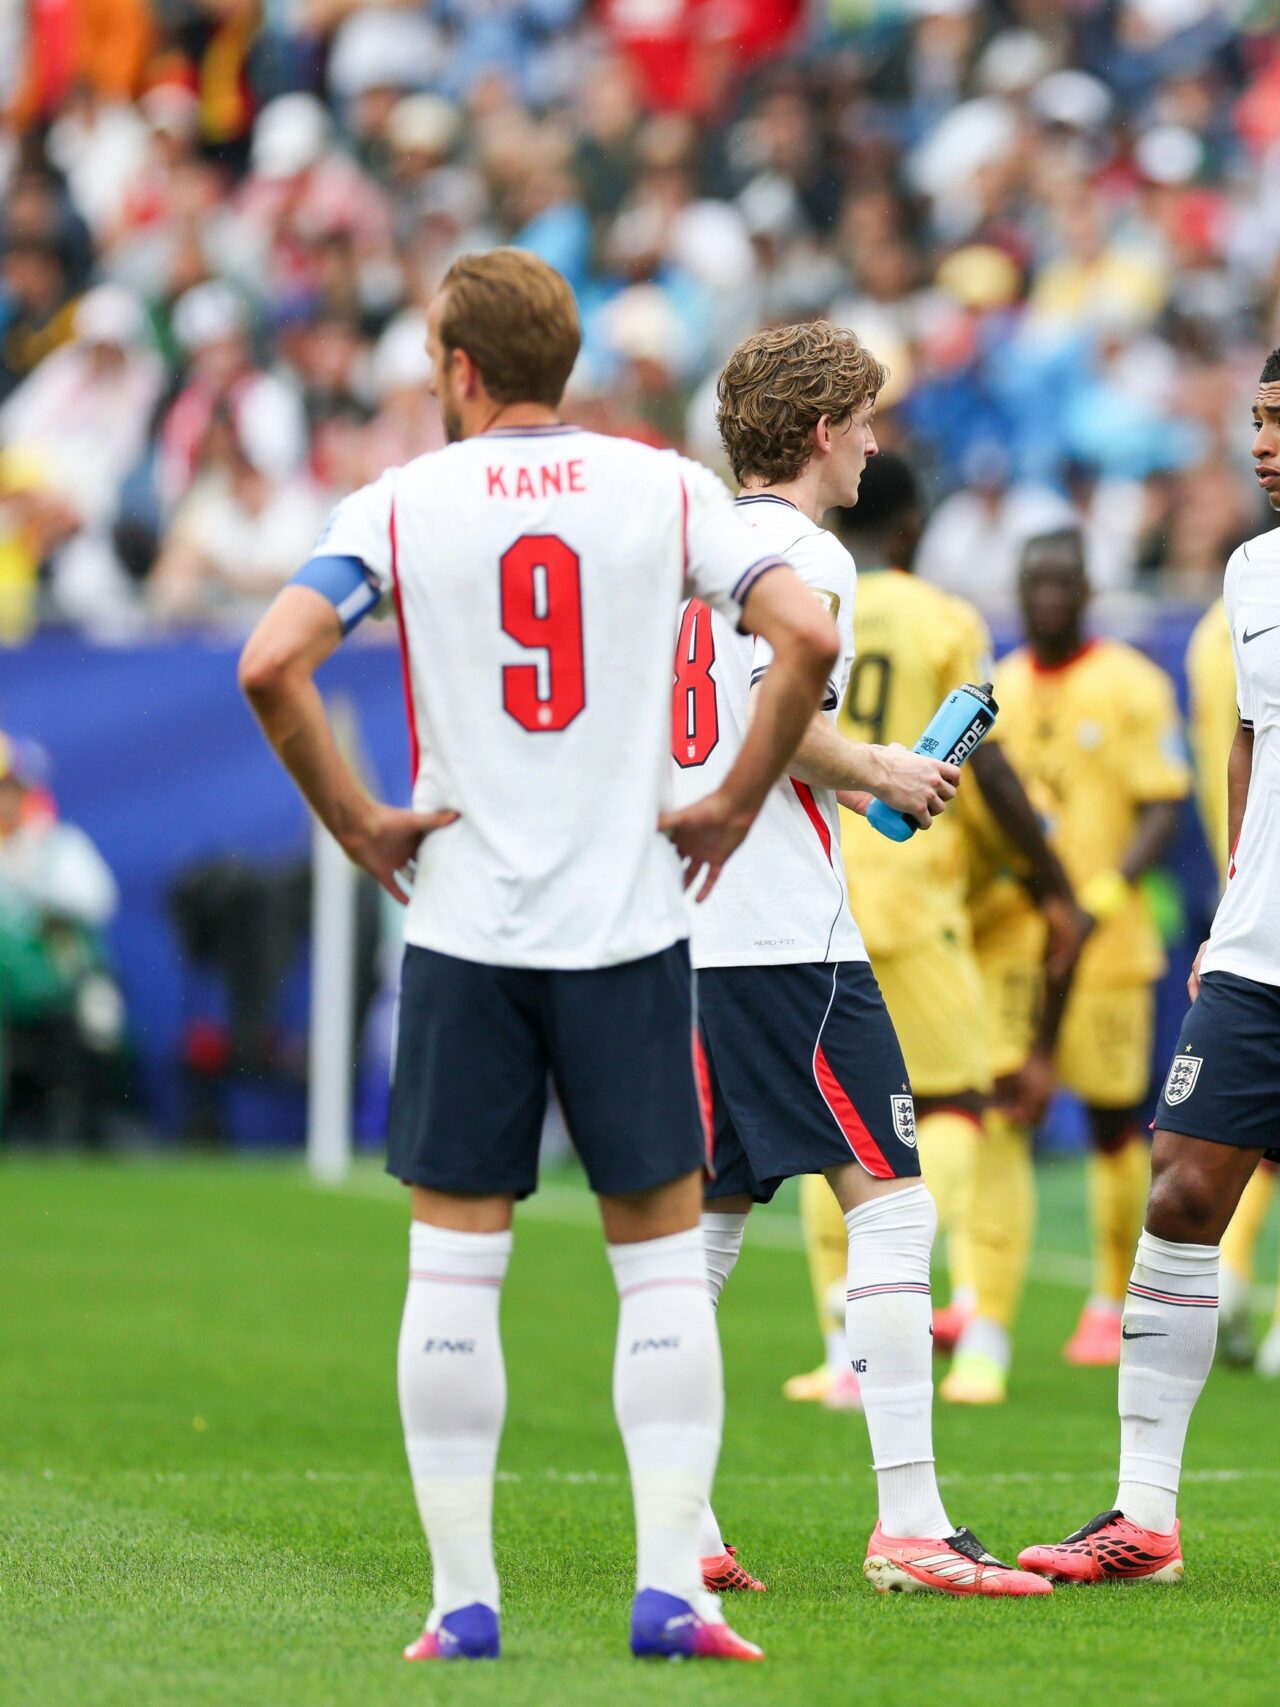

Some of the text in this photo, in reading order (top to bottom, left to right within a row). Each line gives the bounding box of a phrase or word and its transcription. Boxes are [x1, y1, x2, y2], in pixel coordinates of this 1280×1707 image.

[486, 459, 586, 500] KANE
[499, 534, 586, 732] 9
[672, 596, 719, 769] 8
[945, 718, 987, 766] RADE
[424, 1338, 477, 1353] ENG
[851, 1359, 867, 1373] NG
